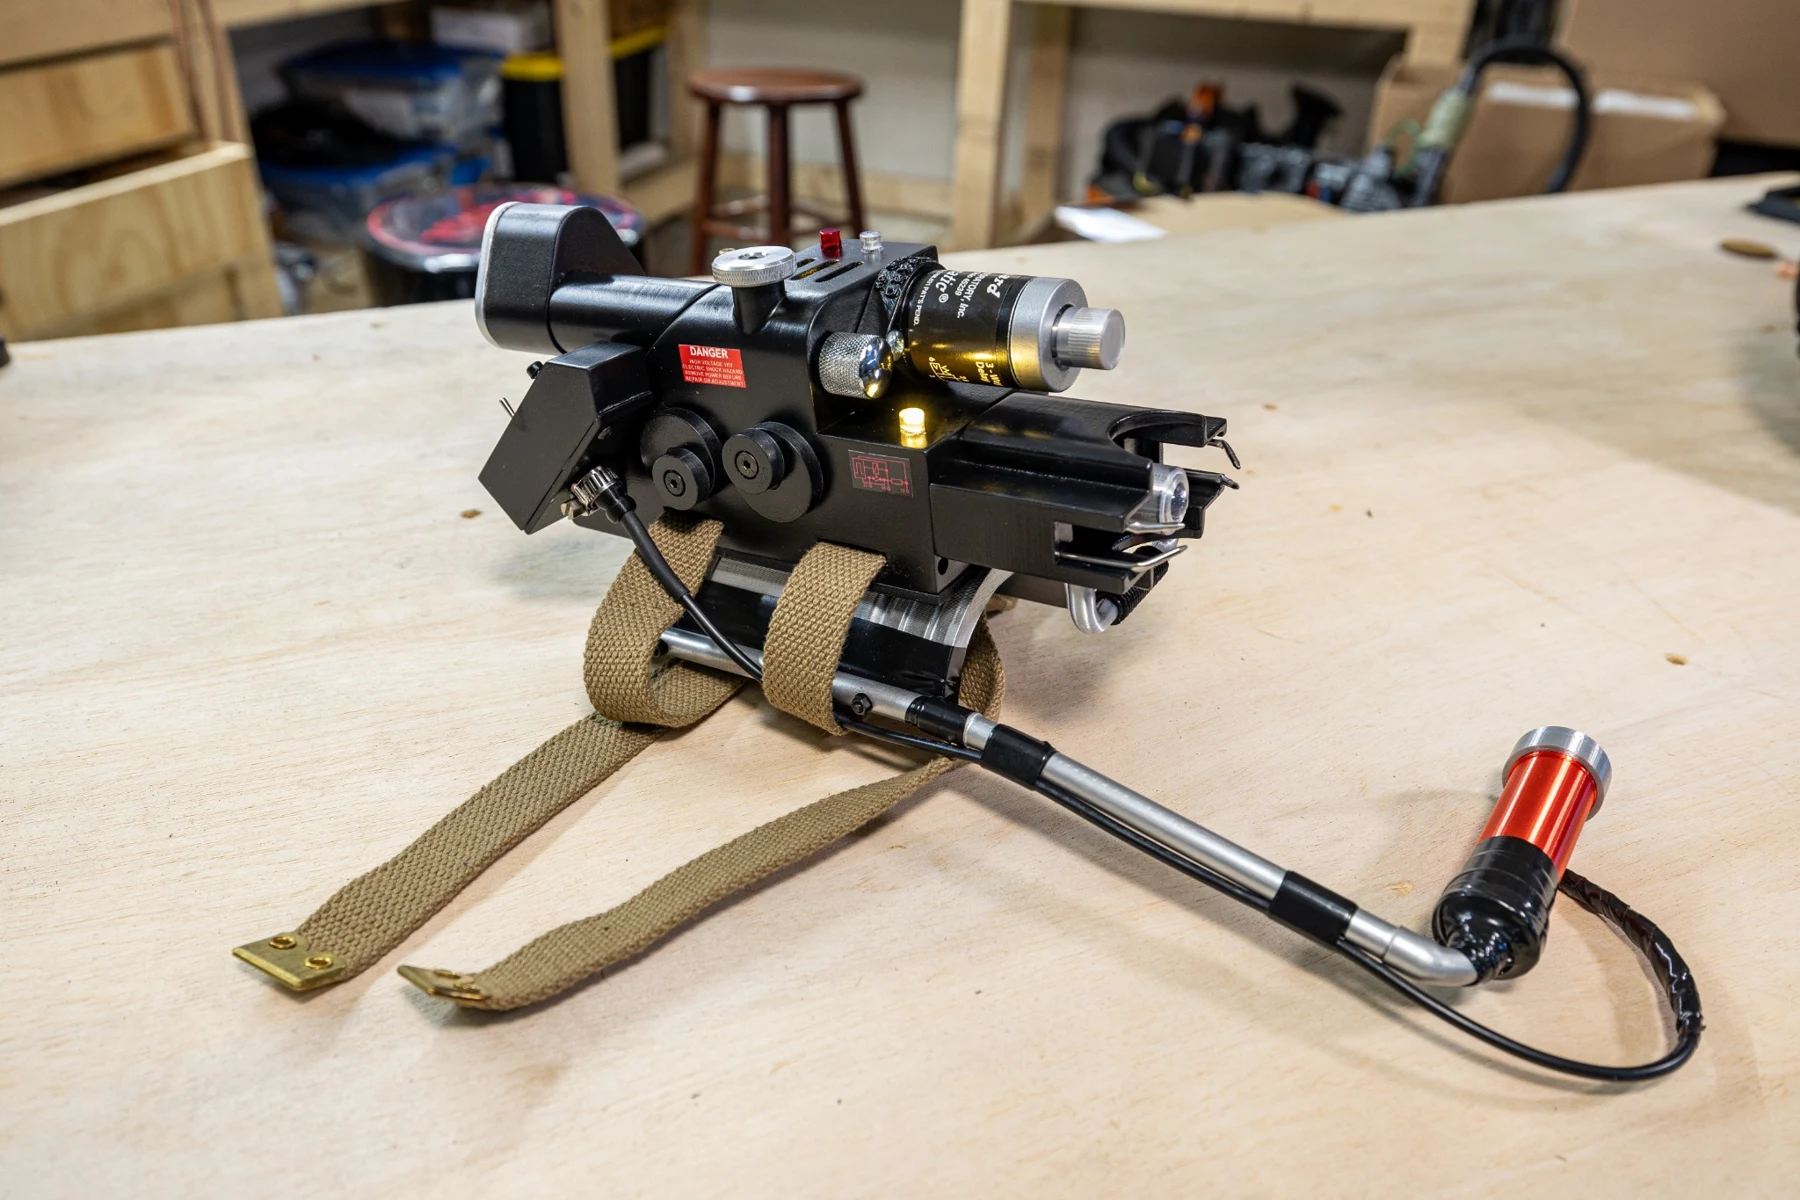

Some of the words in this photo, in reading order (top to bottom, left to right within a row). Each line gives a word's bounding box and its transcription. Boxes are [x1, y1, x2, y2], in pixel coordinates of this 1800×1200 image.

[913, 304, 922, 326] PEND.
[957, 303, 969, 319] Inc.
[690, 346, 729, 359] DANGER
